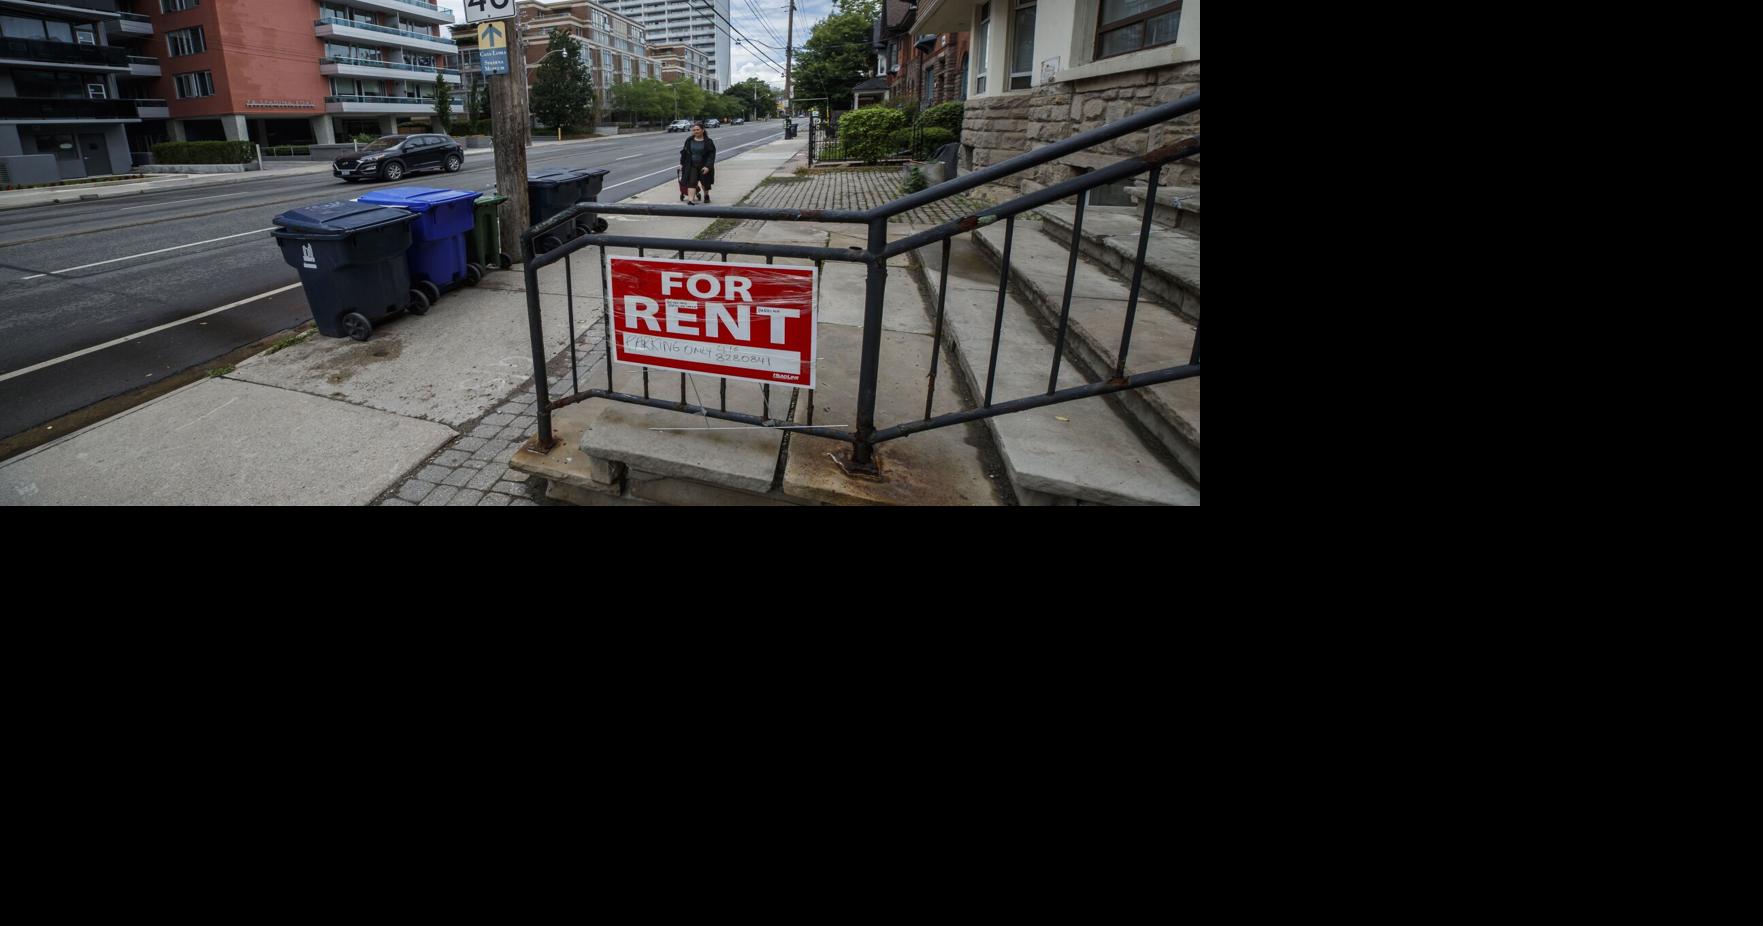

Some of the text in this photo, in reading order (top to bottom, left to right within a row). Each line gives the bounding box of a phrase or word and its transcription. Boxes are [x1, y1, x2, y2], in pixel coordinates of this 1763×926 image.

[661, 271, 752, 302] FOR
[624, 296, 800, 344] RENT
[626, 335, 712, 358] PARKING ONLY
